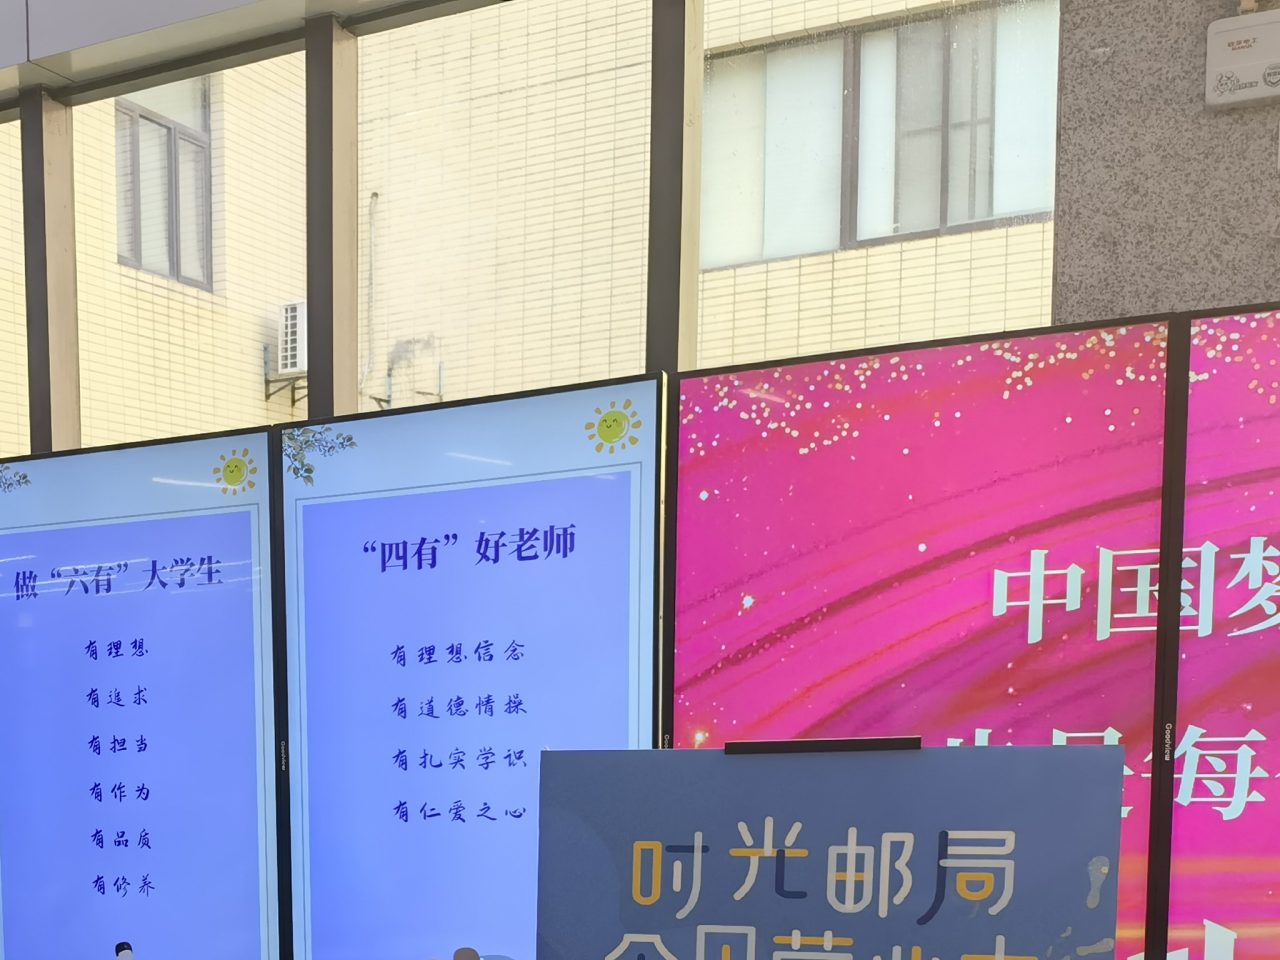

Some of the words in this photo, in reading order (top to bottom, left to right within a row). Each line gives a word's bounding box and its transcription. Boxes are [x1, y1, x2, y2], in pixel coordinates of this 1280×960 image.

[362, 524, 577, 573] “四有”好老师
[84, 638, 149, 661] 有理想
[390, 640, 525, 667] 有理想信念
[86, 685, 149, 708] 有追求
[391, 693, 527, 719] 有道德情操
[87, 734, 148, 756] 有担当
[392, 747, 527, 771] 有扎实学识
[89, 782, 151, 802] 有作为
[393, 800, 527, 823] 有仁爱之心
[91, 828, 152, 850] 有品质
[632, 816, 1016, 926] 时光邮局
[92, 874, 156, 898] 有修养
